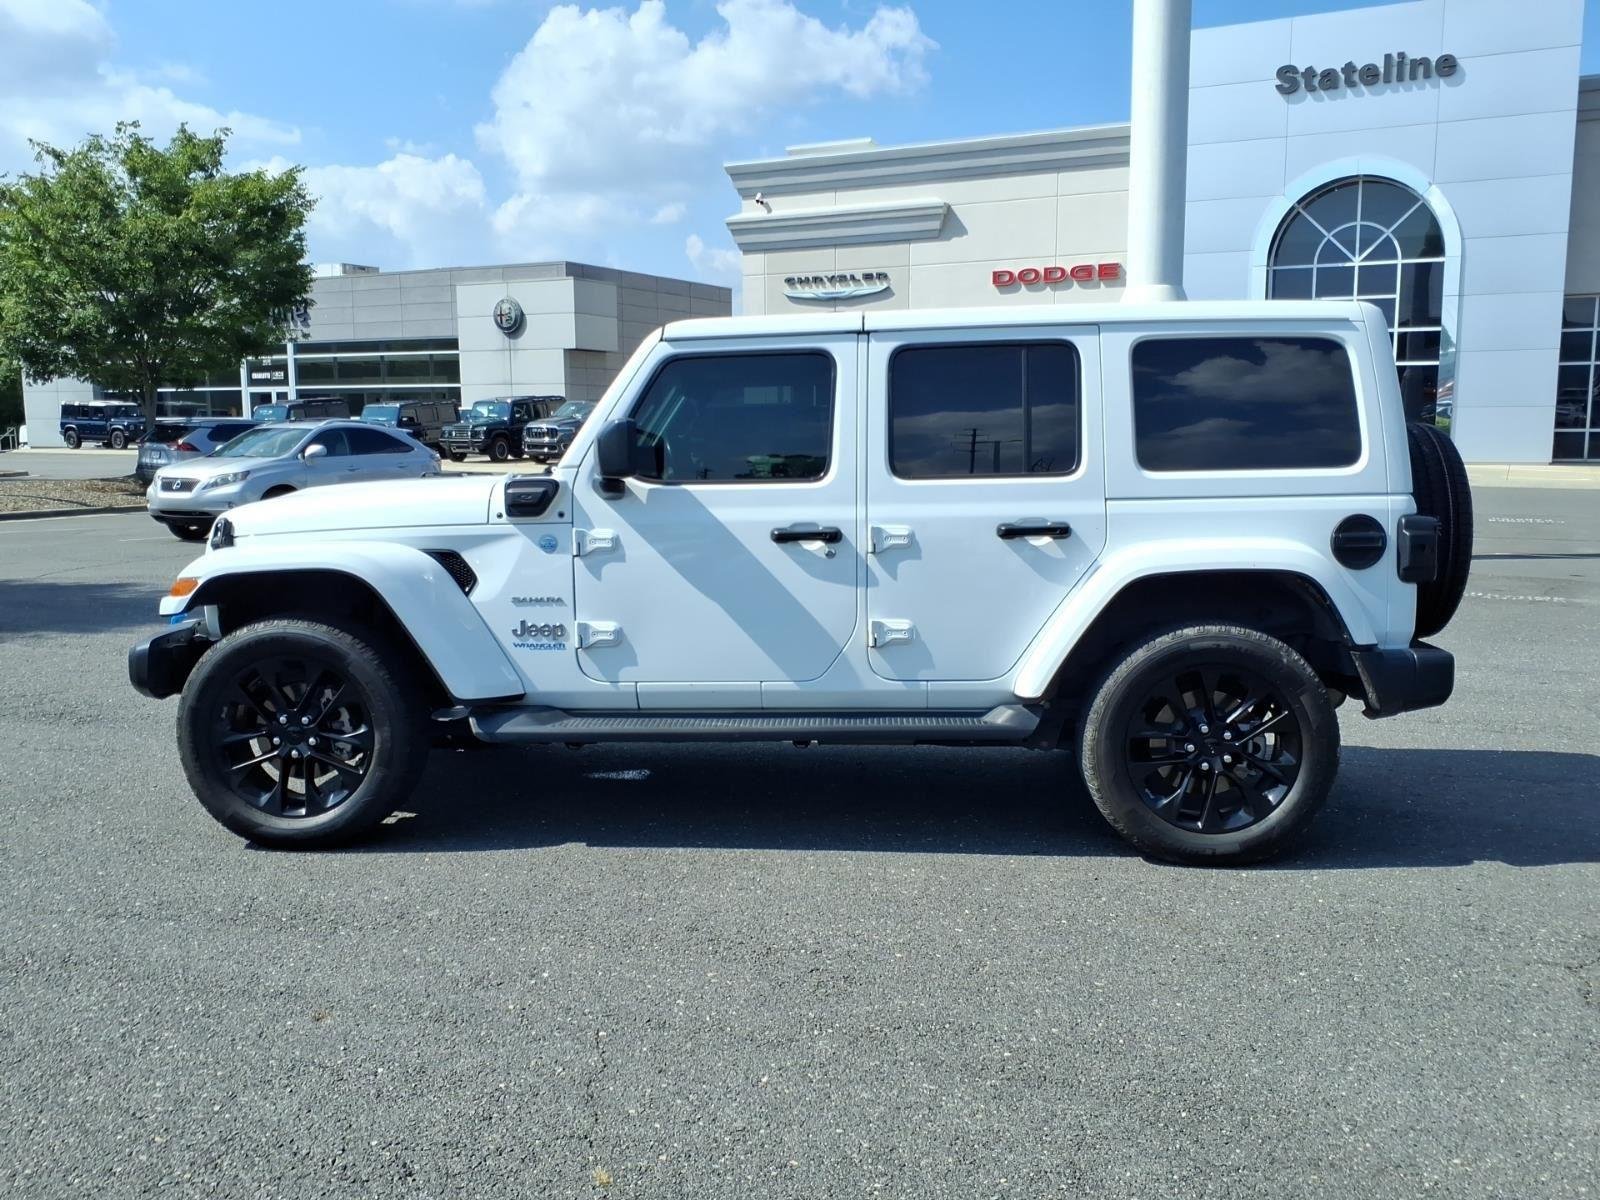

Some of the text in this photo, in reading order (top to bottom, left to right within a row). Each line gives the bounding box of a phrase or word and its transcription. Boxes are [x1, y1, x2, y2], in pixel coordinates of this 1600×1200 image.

[1275, 52, 1457, 94] Stateline
[784, 272, 889, 286] CHRYSLER
[992, 263, 1120, 286] DODGE
[512, 620, 567, 641] Jeep
